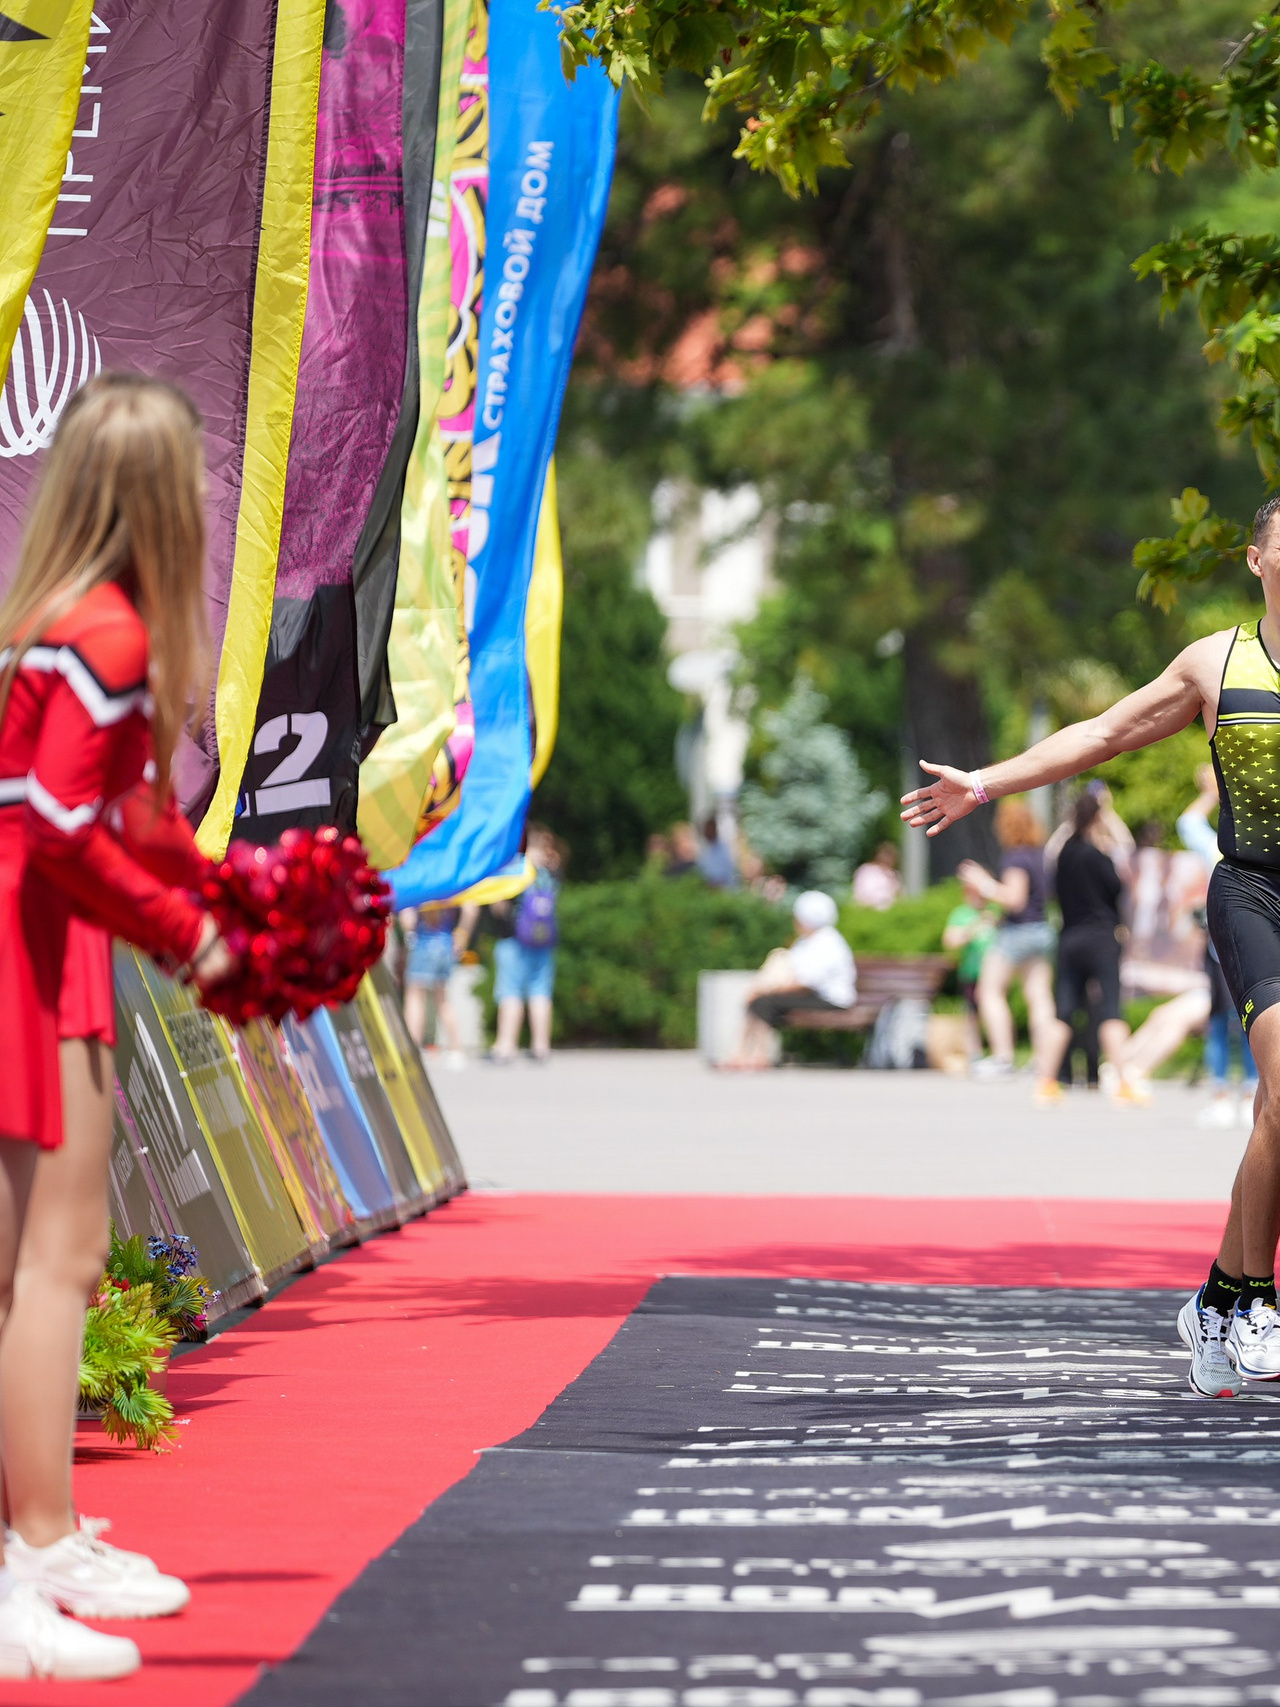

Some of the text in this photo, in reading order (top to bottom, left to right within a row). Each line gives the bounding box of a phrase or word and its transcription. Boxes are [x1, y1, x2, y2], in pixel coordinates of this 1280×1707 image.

[482, 230, 536, 430] СТРАХОВОЙ
[516, 141, 554, 224] ДОМ
[752, 1340, 977, 1354] IRON
[726, 1383, 971, 1395] IRON
[628, 1506, 943, 1526] IRON
[574, 1584, 937, 1610] IRON
[502, 1684, 923, 1707] IRON
